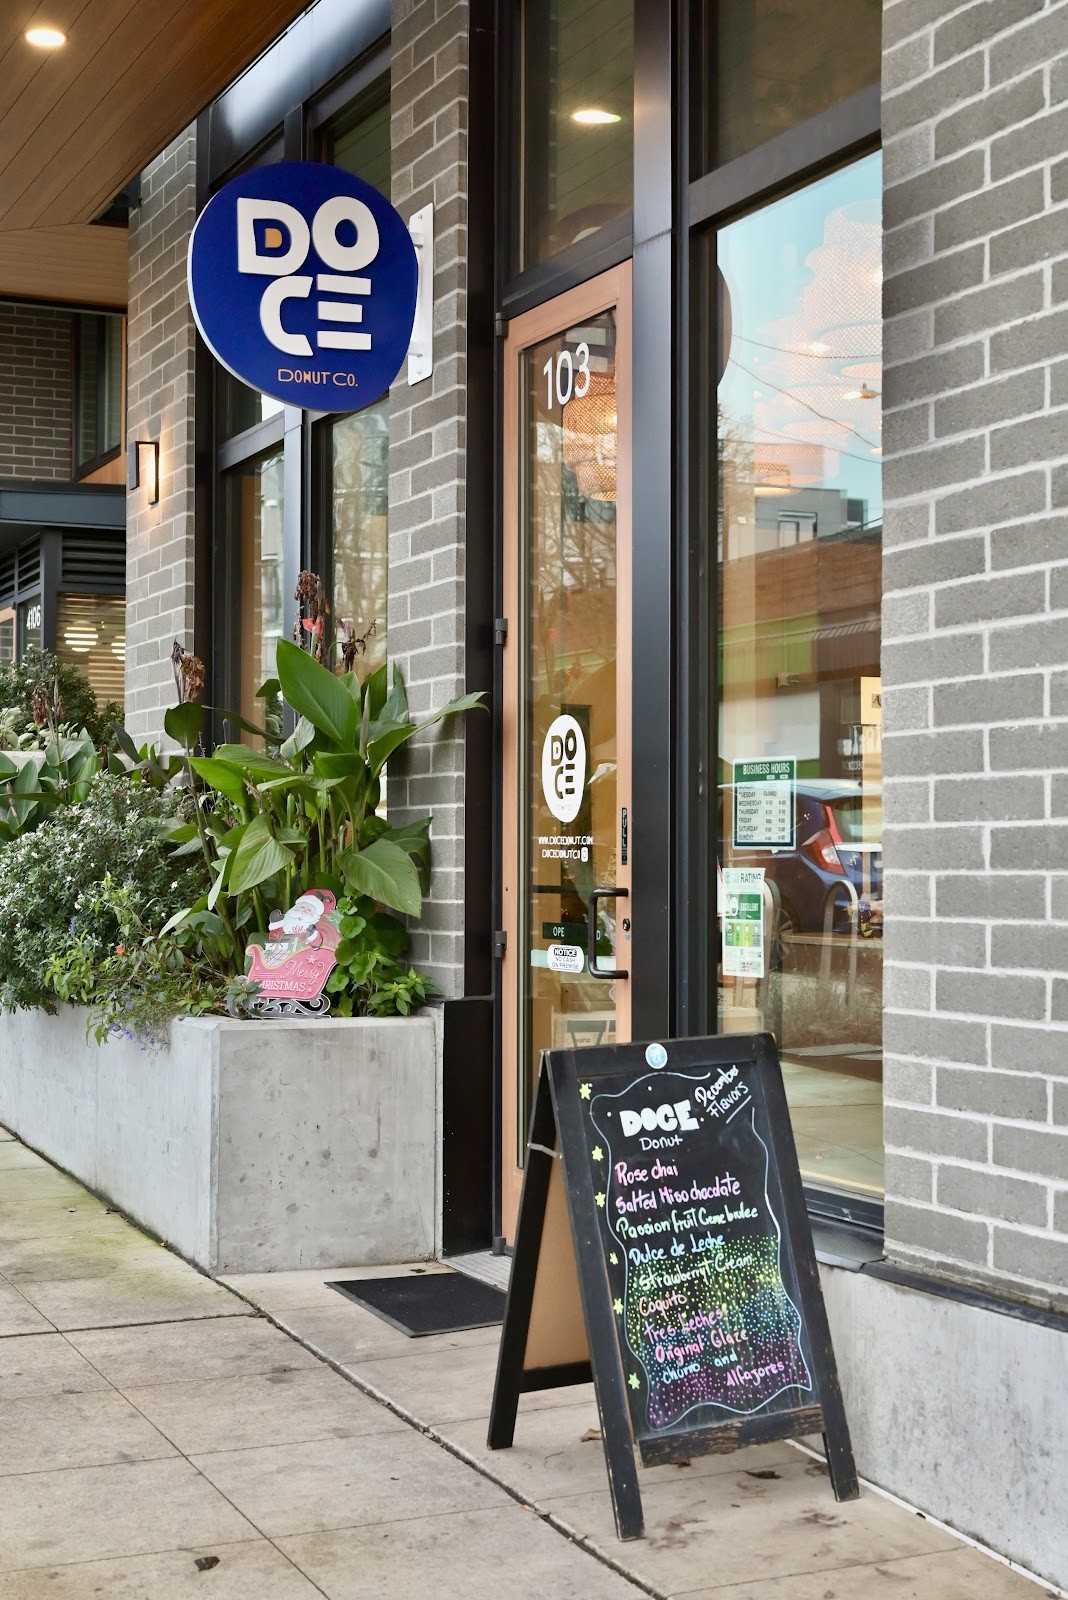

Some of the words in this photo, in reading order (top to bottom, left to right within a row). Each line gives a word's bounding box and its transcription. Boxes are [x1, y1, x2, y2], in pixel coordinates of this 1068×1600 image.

[277, 368, 331, 385] DONUT
[332, 372, 359, 387] CO.
[543, 342, 591, 410] 103
[26, 604, 41, 630] 4106
[742, 763, 770, 775] BUSINESS
[770, 762, 790, 774] HOURS
[554, 948, 577, 957] NOTICE
[280, 960, 325, 984] Merry
[259, 980, 306, 992] HRISTMAS
[706, 1081, 749, 1117] Flavors
[619, 1099, 700, 1137] DOCE
[639, 1134, 683, 1151] Donut
[615, 1161, 649, 1186] Rose
[651, 1158, 678, 1179] chai
[615, 1189, 657, 1214] Salted
[658, 1186, 689, 1205] Miso
[615, 1216, 671, 1240] Passion
[671, 1207, 698, 1233] fruit
[629, 1242, 667, 1266] Dulce
[670, 1237, 686, 1257] de
[690, 1231, 725, 1253] Leche
[715, 1253, 753, 1273] Cream
[639, 1290, 687, 1320] Coquito
[678, 1308, 723, 1335] Leches
[655, 1333, 704, 1367] Original
[710, 1327, 749, 1348] Glaze
[714, 1348, 738, 1368] and
